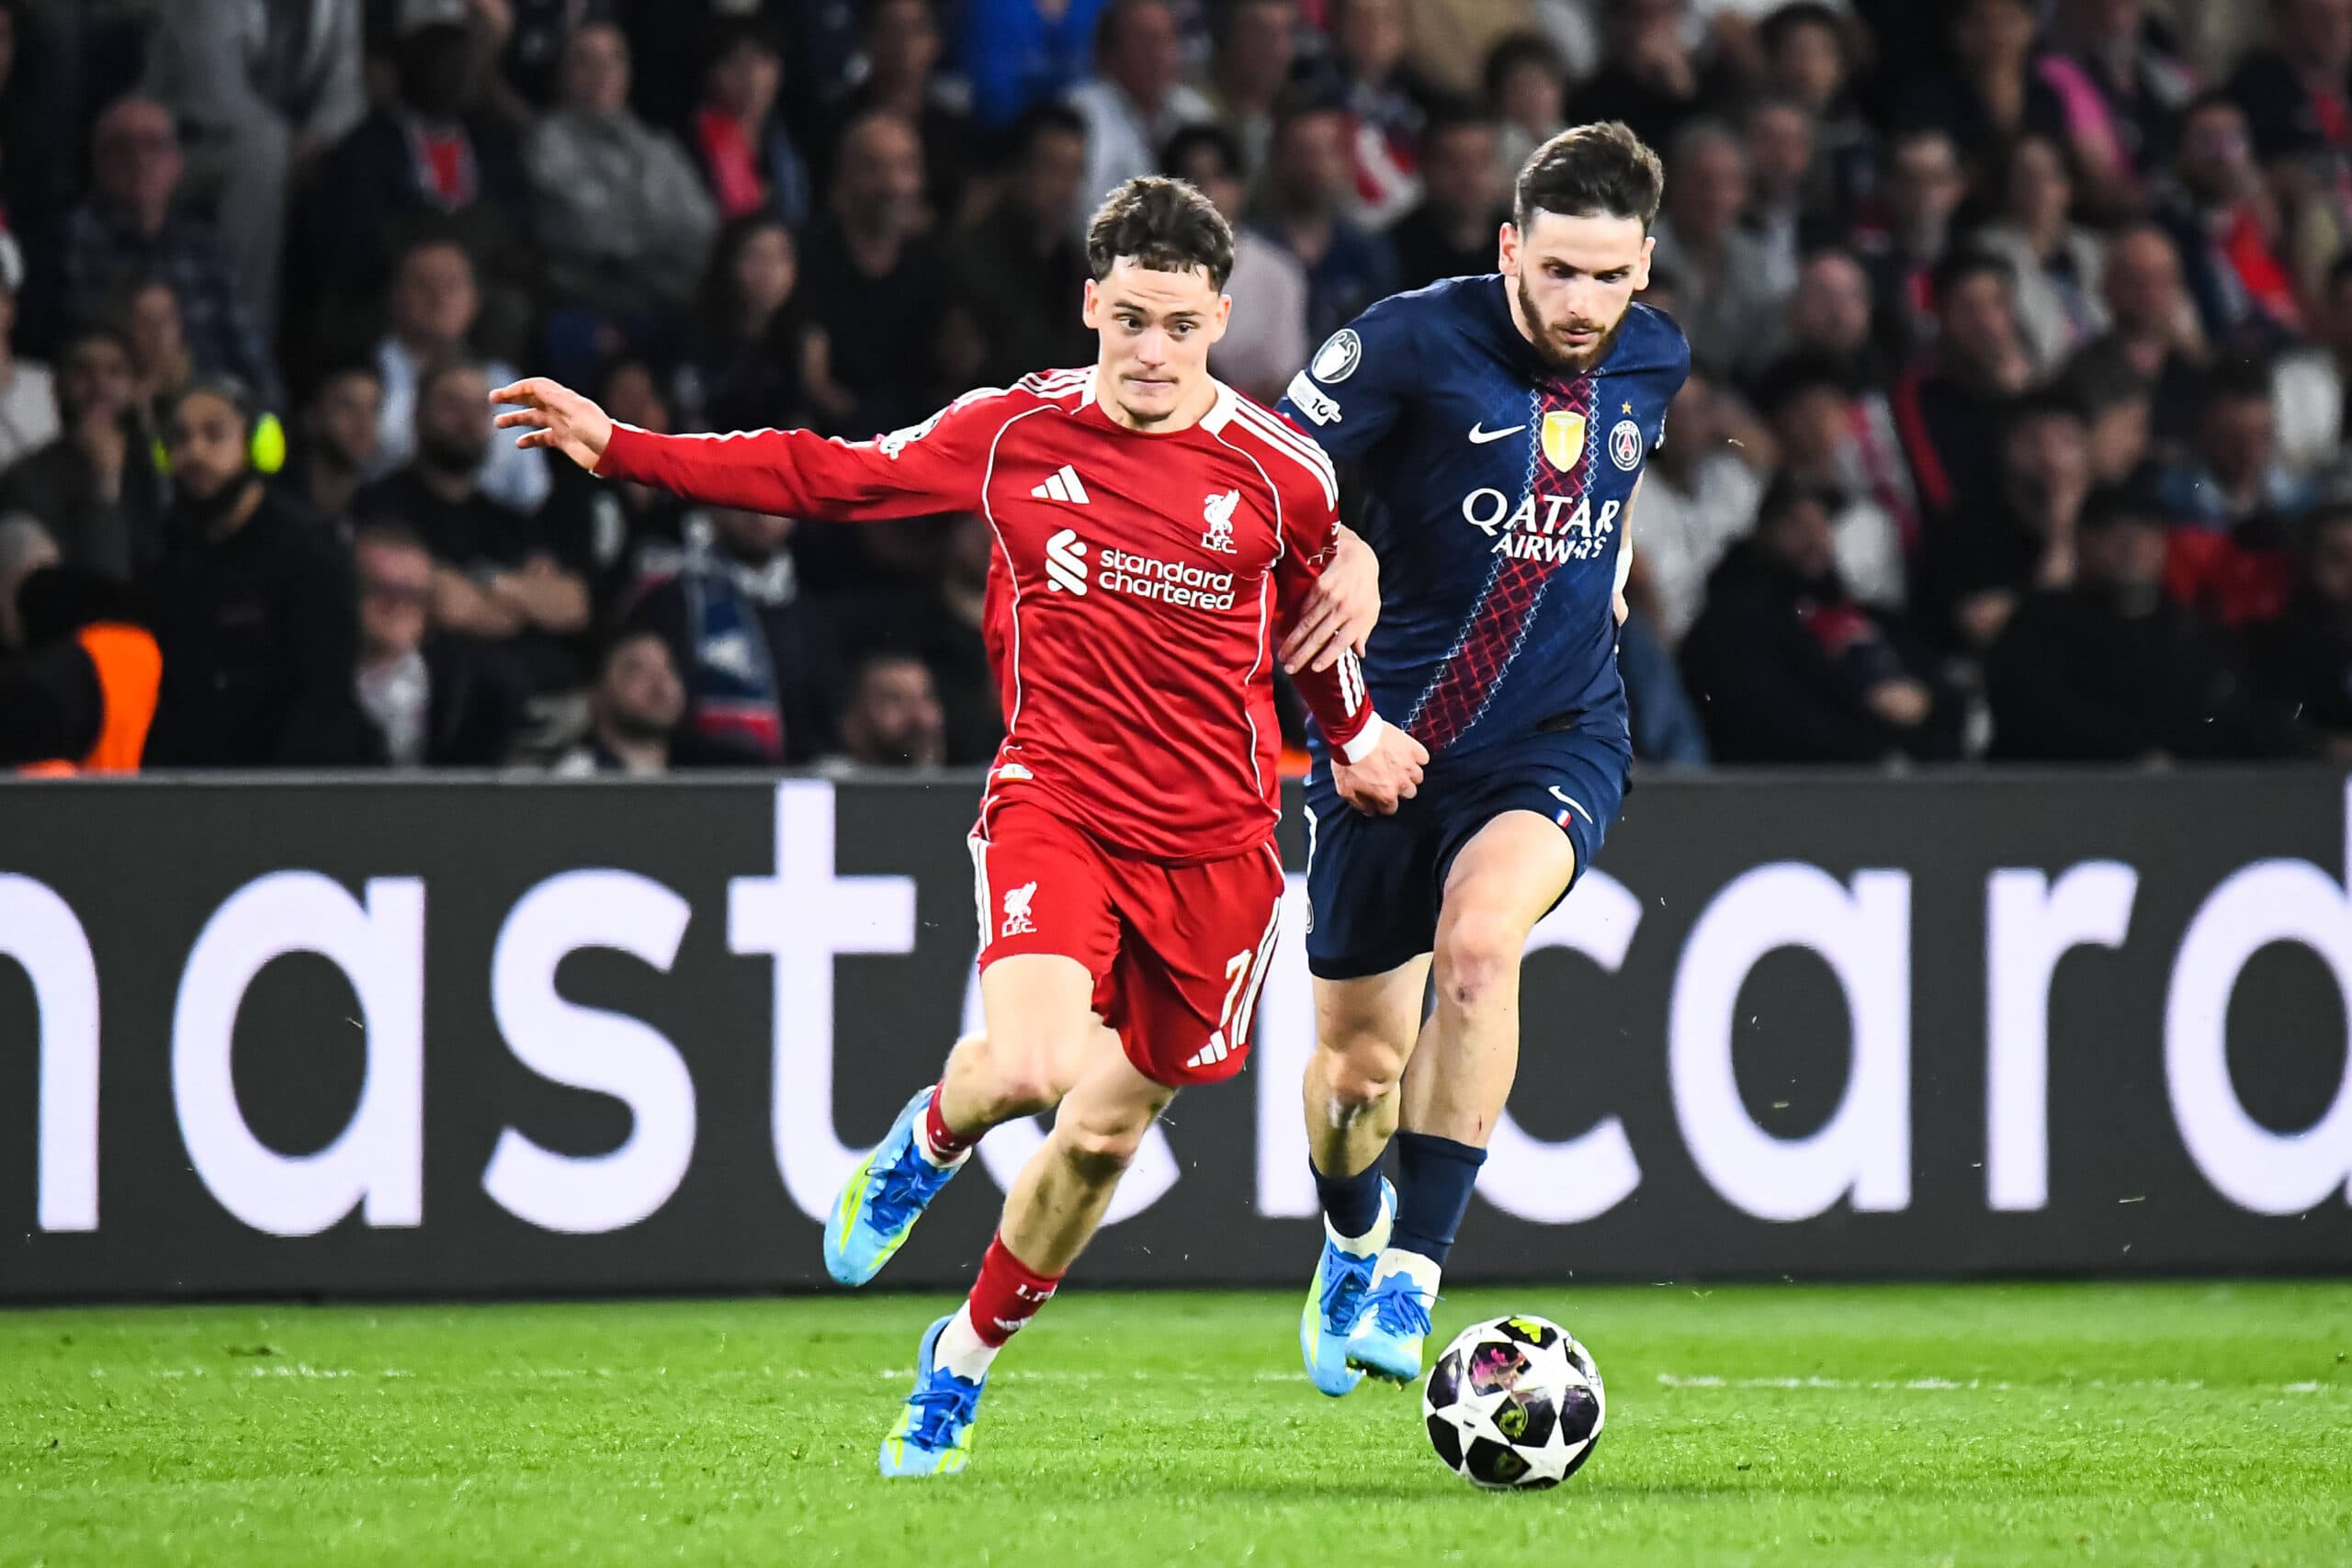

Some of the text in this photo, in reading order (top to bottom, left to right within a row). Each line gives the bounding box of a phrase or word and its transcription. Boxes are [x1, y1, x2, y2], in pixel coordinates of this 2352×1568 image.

[1463, 488, 1620, 538] QATAR
[1098, 570, 1236, 611] chartered
[1100, 548, 1234, 592] standard
[0, 778, 2352, 1236] astrcard
[1218, 948, 1253, 1028] 7
